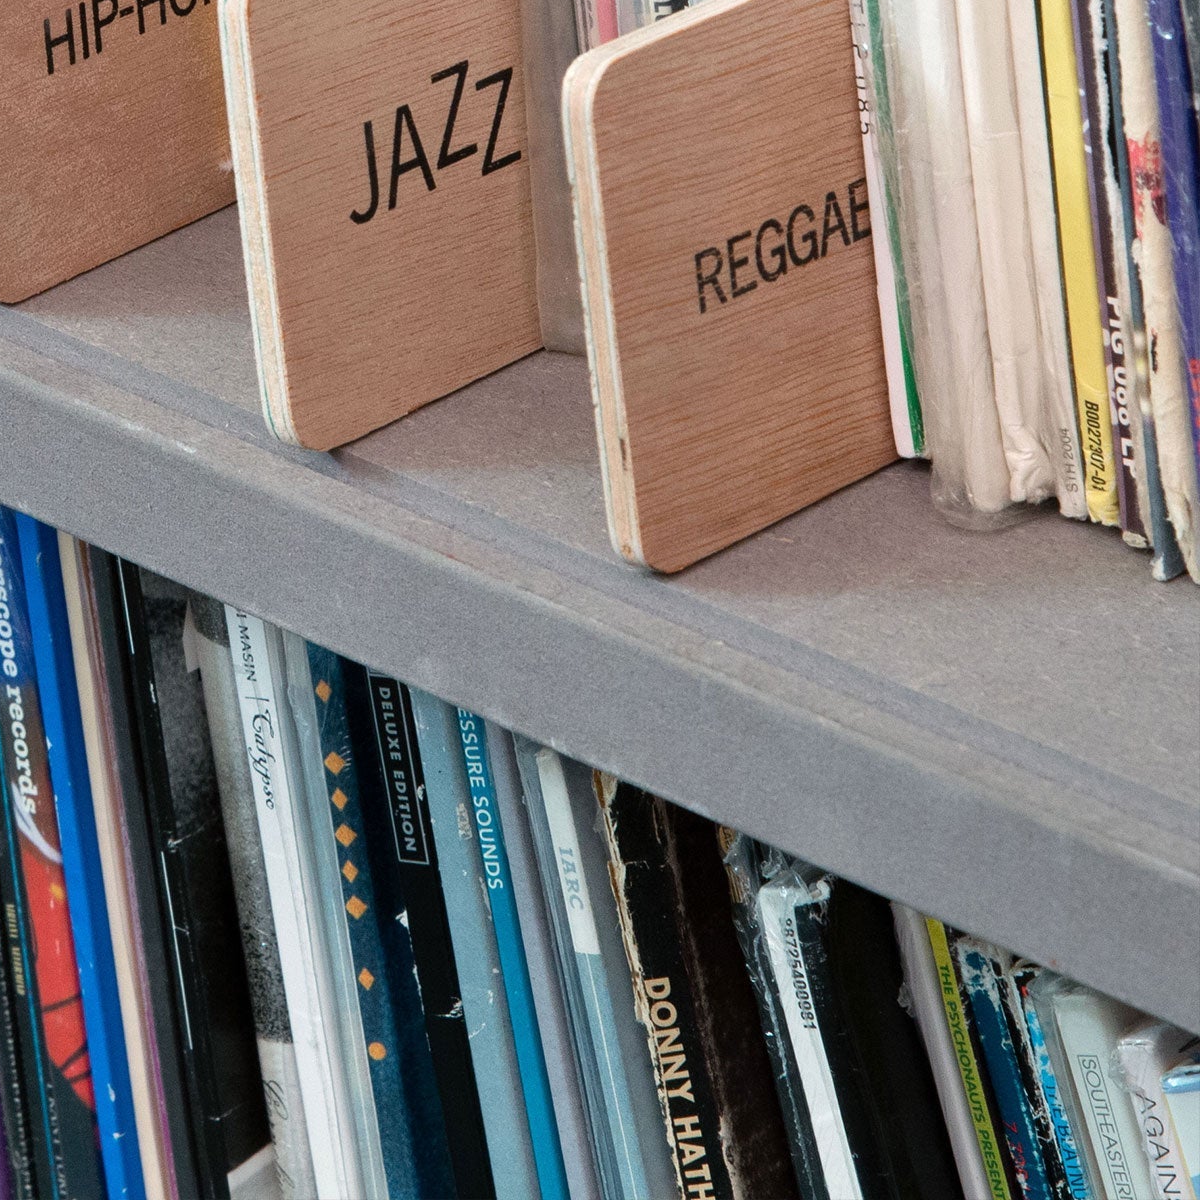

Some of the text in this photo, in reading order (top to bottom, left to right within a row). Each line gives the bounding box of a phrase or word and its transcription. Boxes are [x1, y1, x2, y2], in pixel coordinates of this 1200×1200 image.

[349, 60, 522, 225] JAZZ
[694, 177, 872, 314] REGGAE
[238, 625, 258, 683] MASIN
[5, 684, 38, 815] records
[247, 705, 276, 810] Calypso
[379, 686, 418, 852] DELUXE EDITION
[473, 795, 504, 890] SOUNDS
[644, 976, 695, 1103] DONNY
[939, 965, 1005, 1200] THE PSYCHONAUTS PRESENT
